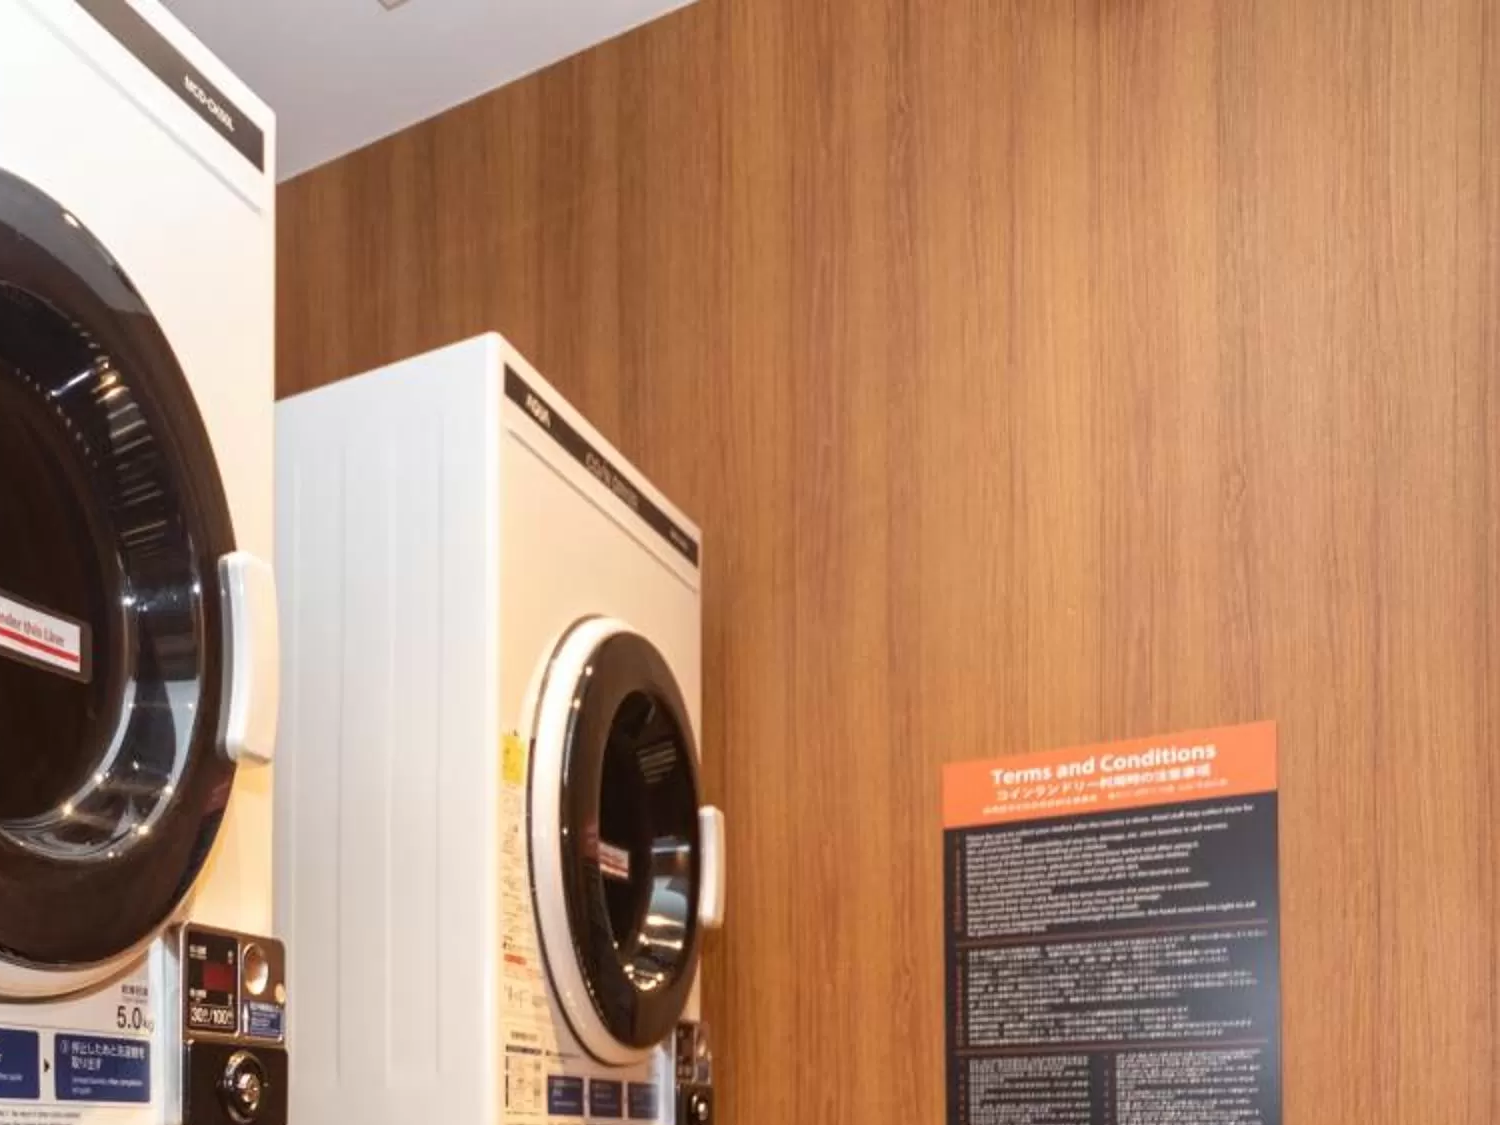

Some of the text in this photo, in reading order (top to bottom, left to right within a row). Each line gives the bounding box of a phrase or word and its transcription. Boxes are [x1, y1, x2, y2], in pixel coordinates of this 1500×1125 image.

[24, 619, 42, 639] this
[990, 744, 1217, 785] Terms and Conditions
